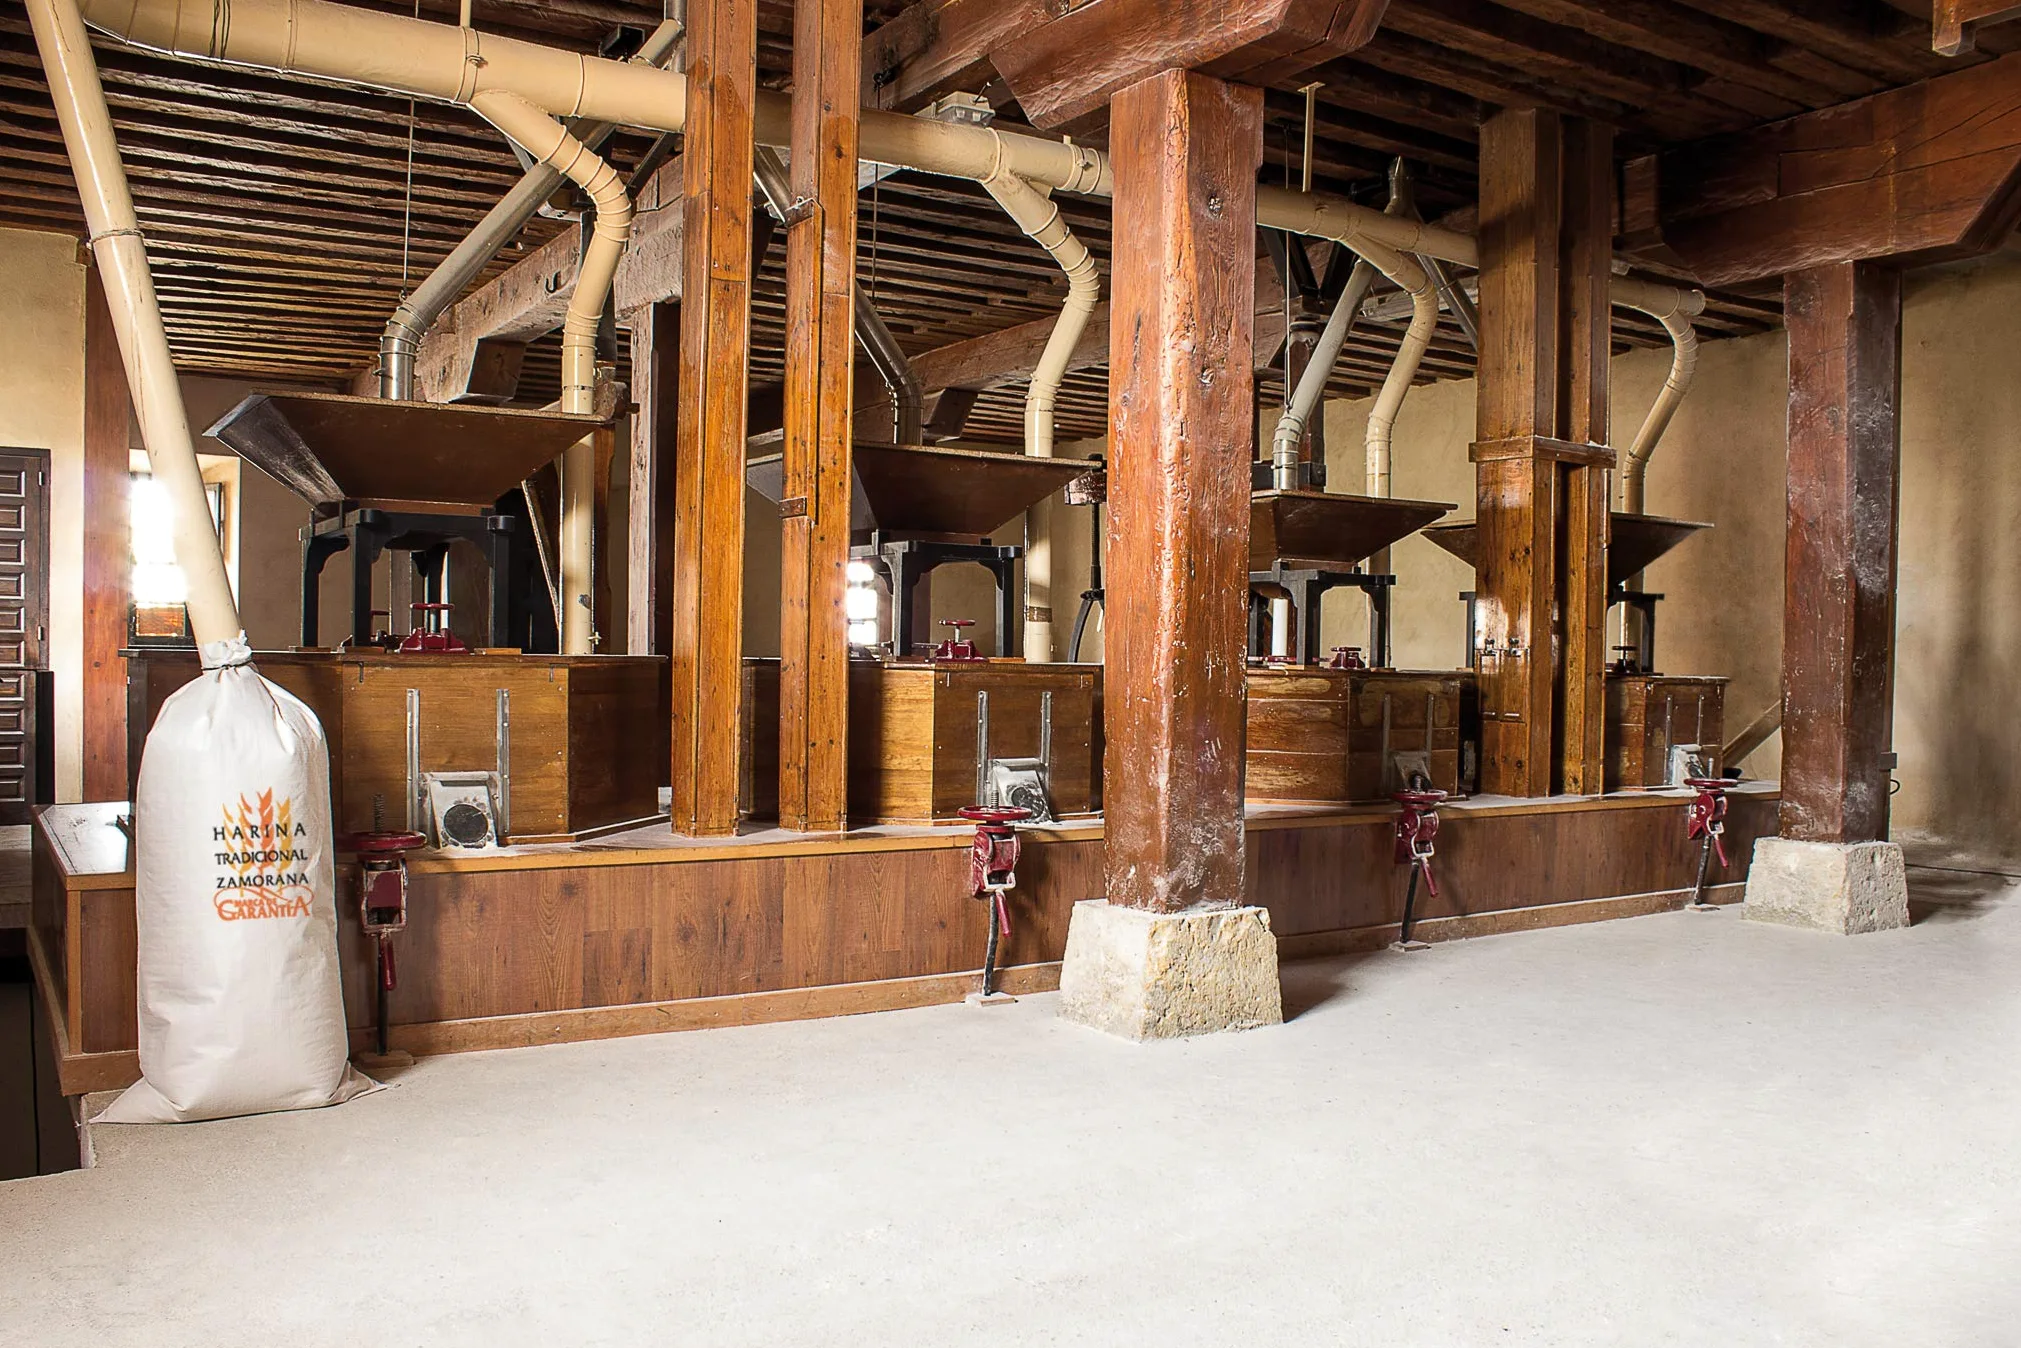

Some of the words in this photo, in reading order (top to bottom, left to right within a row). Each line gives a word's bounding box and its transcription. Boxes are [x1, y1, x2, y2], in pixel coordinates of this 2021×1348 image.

[213, 822, 306, 841] HARINA
[215, 849, 308, 865] TRADICIONAL
[217, 873, 309, 889] ZAMORANA
